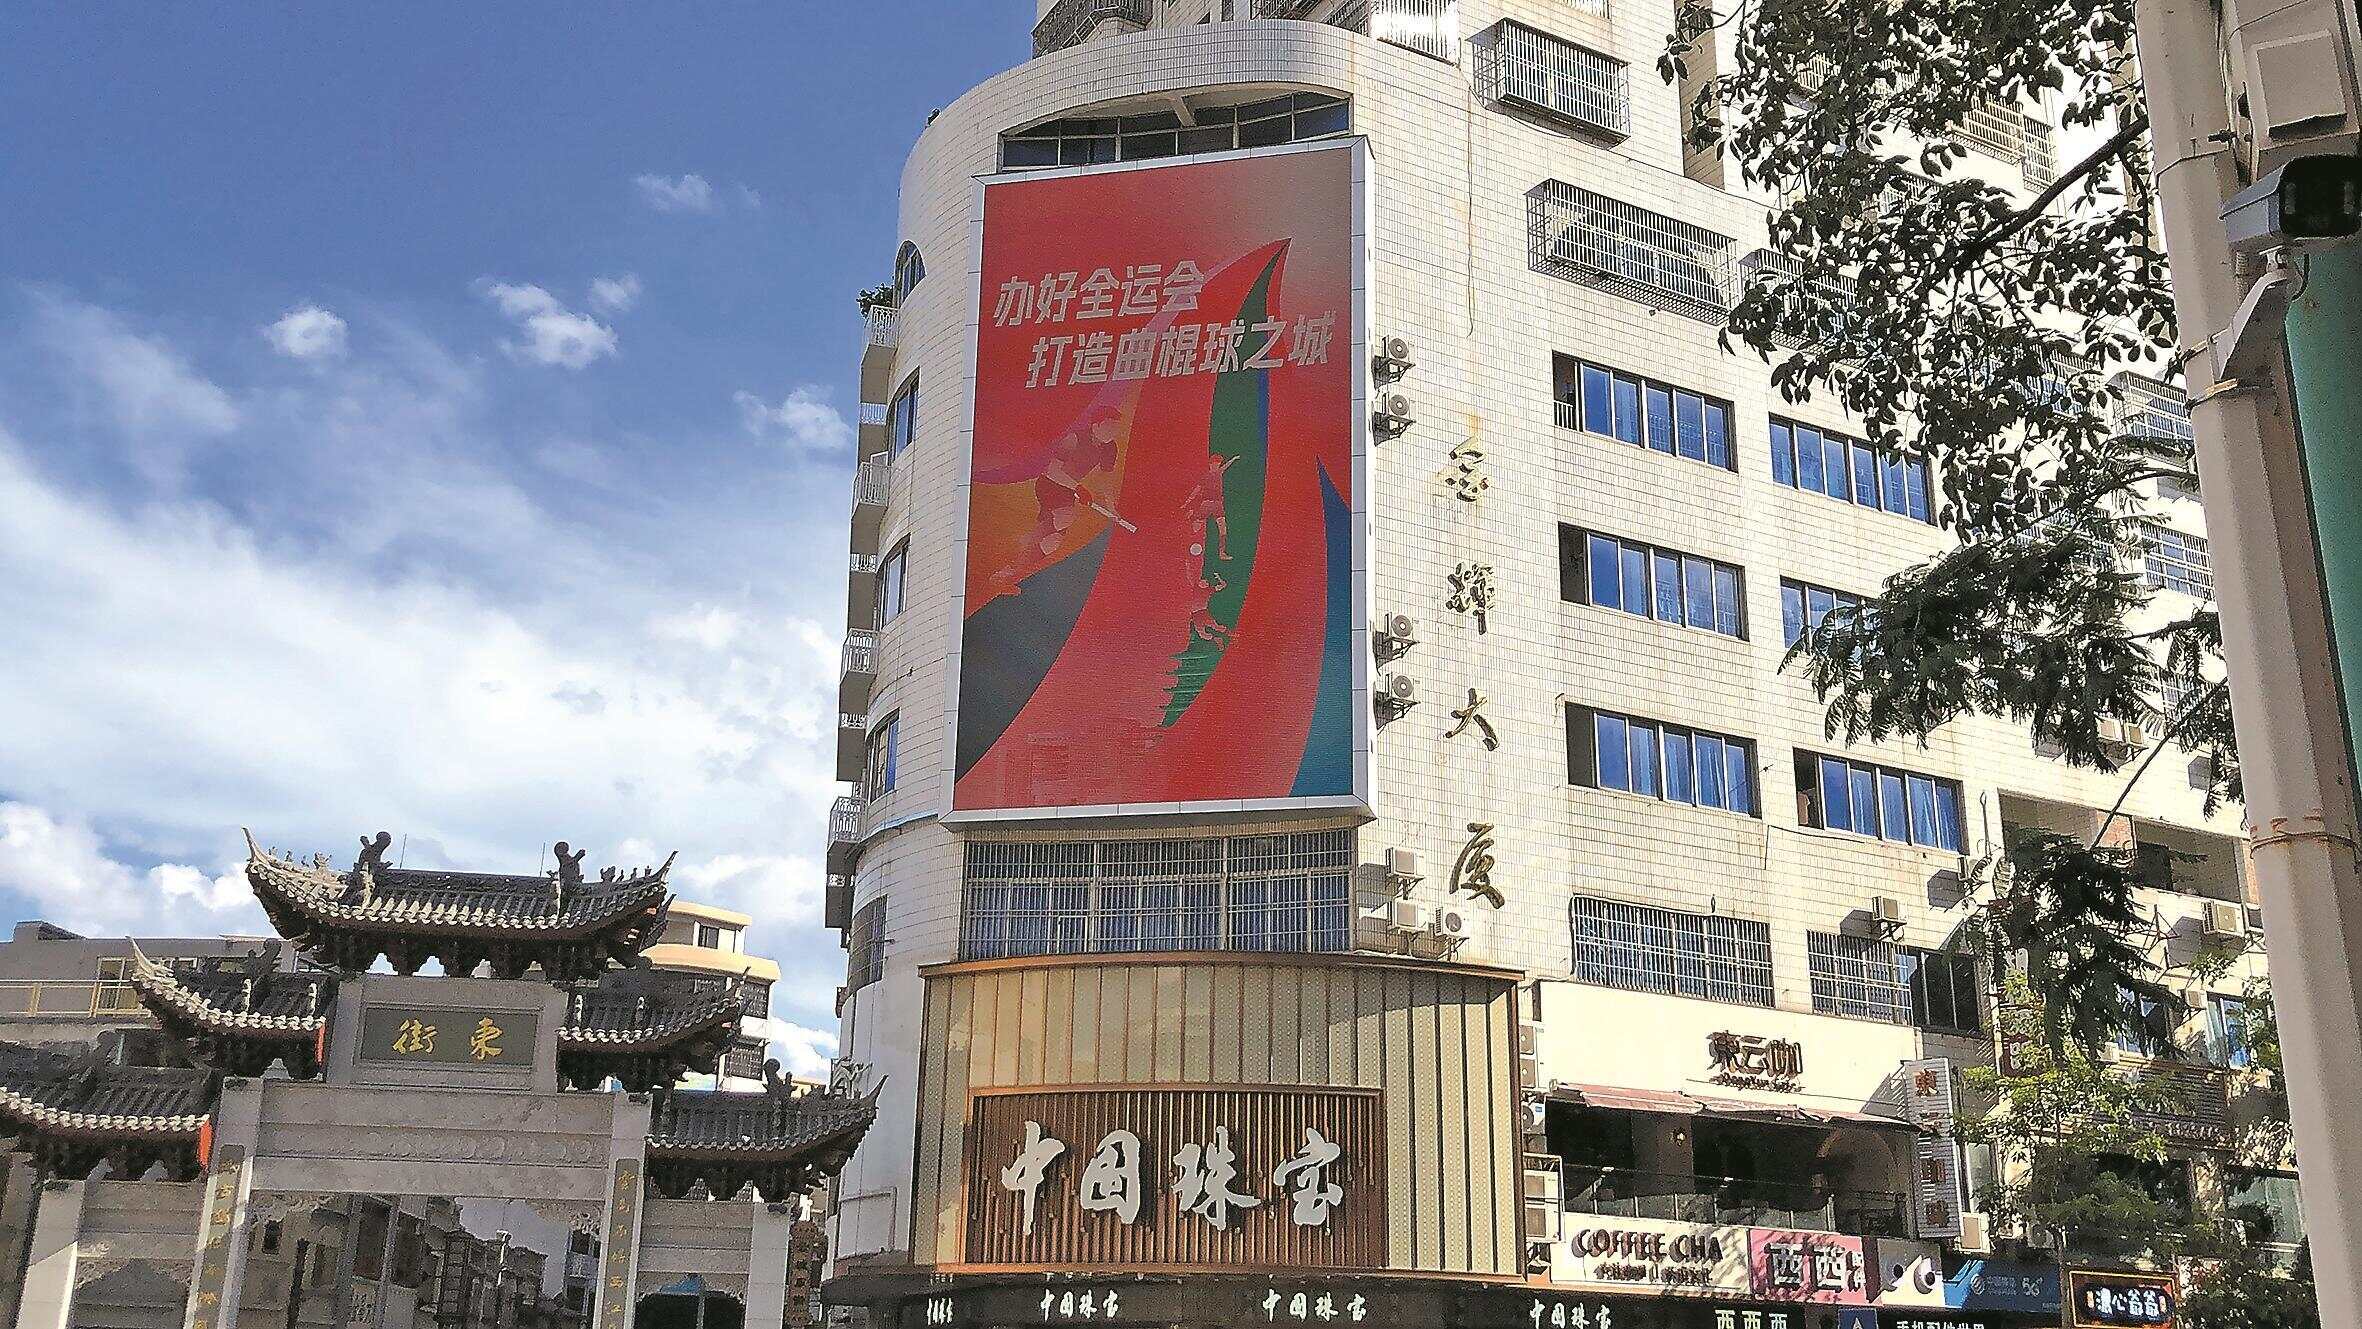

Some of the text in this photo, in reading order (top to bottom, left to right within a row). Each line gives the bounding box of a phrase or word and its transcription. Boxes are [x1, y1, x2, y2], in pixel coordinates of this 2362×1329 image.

[993, 260, 1207, 327] 办好全运会
[1025, 310, 1337, 388] 打造曲棍球之城
[1001, 1120, 1344, 1236] 中国珠宝
[1573, 1229, 1723, 1263] COFFEE CHA
[1040, 1289, 1119, 1321] 中国珠宝
[1262, 1289, 1367, 1322] 中国珠宝
[1529, 1298, 1612, 1329] 中国珠宝
